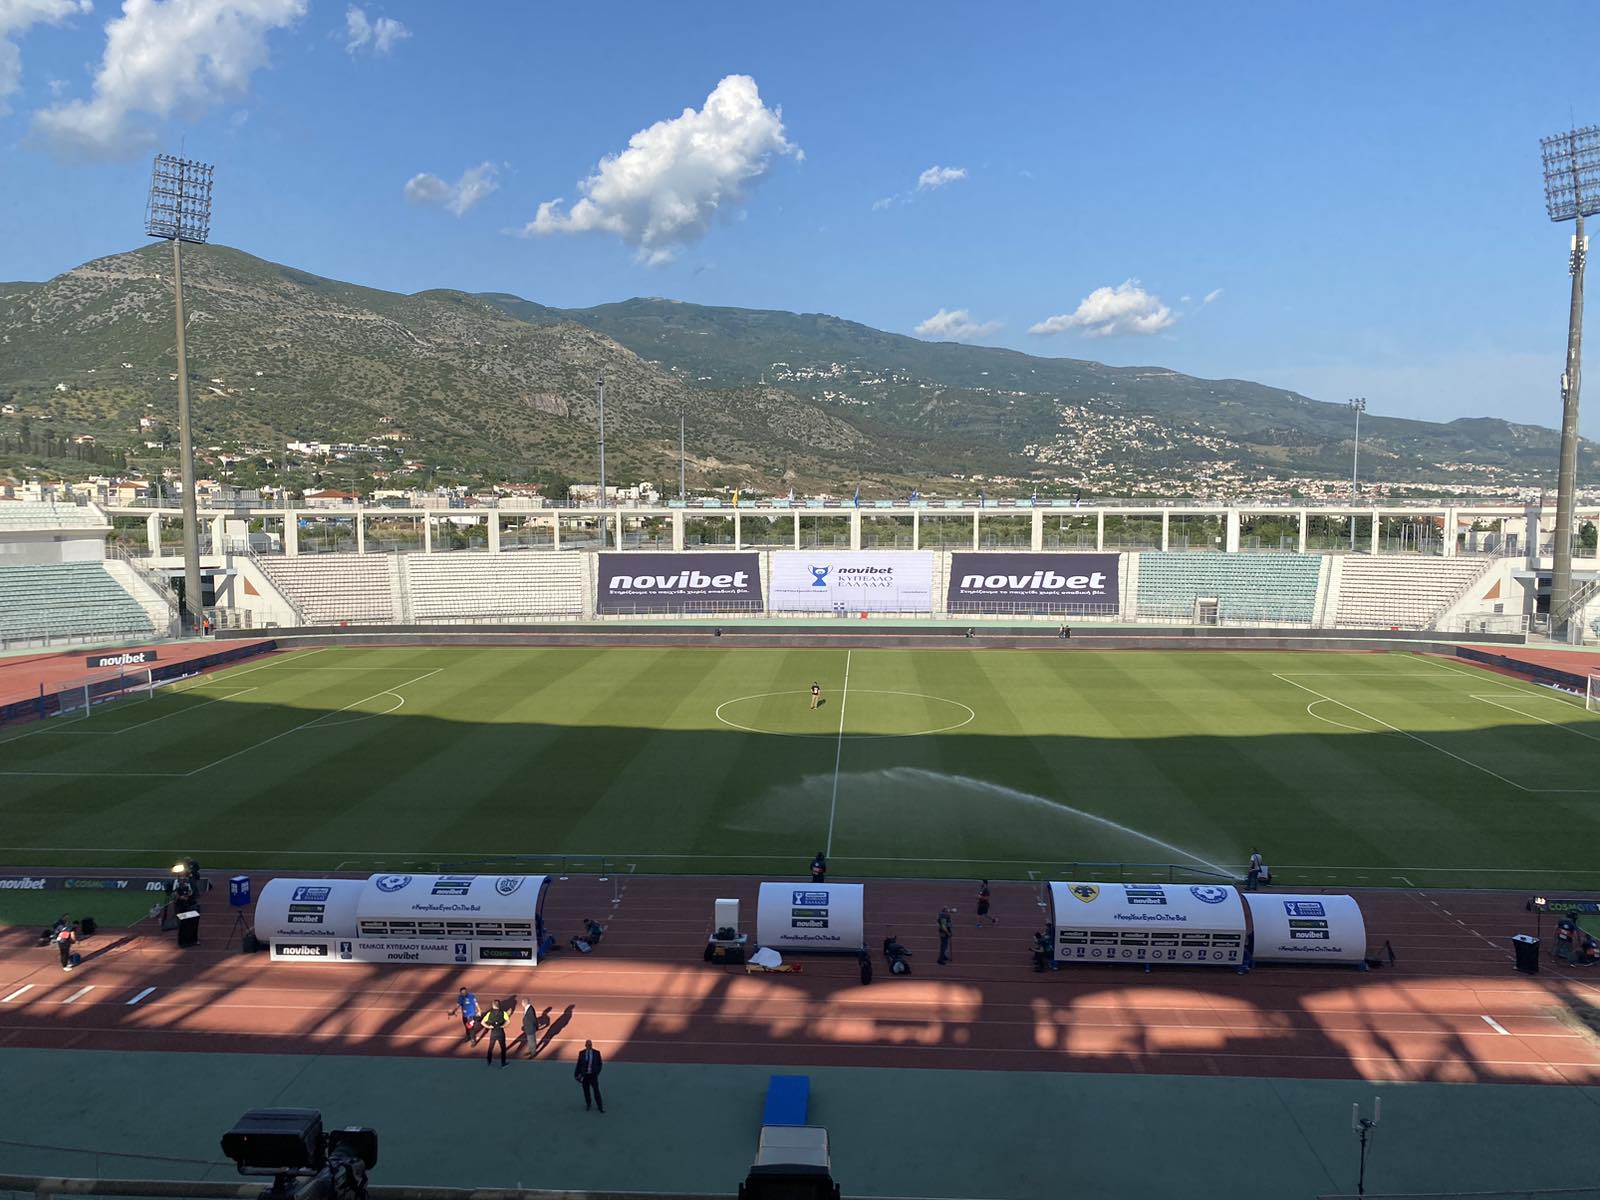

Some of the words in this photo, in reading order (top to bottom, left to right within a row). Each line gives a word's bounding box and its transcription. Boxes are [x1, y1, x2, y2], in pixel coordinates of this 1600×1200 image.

[838, 566, 893, 574] novibet
[609, 571, 748, 589] novibet
[960, 570, 1106, 589] novibet
[100, 652, 145, 667] novibet
[0, 877, 45, 890] novibet
[116, 879, 128, 889] TV
[796, 920, 823, 928] novibet
[1295, 931, 1323, 939] novibet
[283, 945, 320, 955] novibet
[387, 952, 420, 960] novibet
